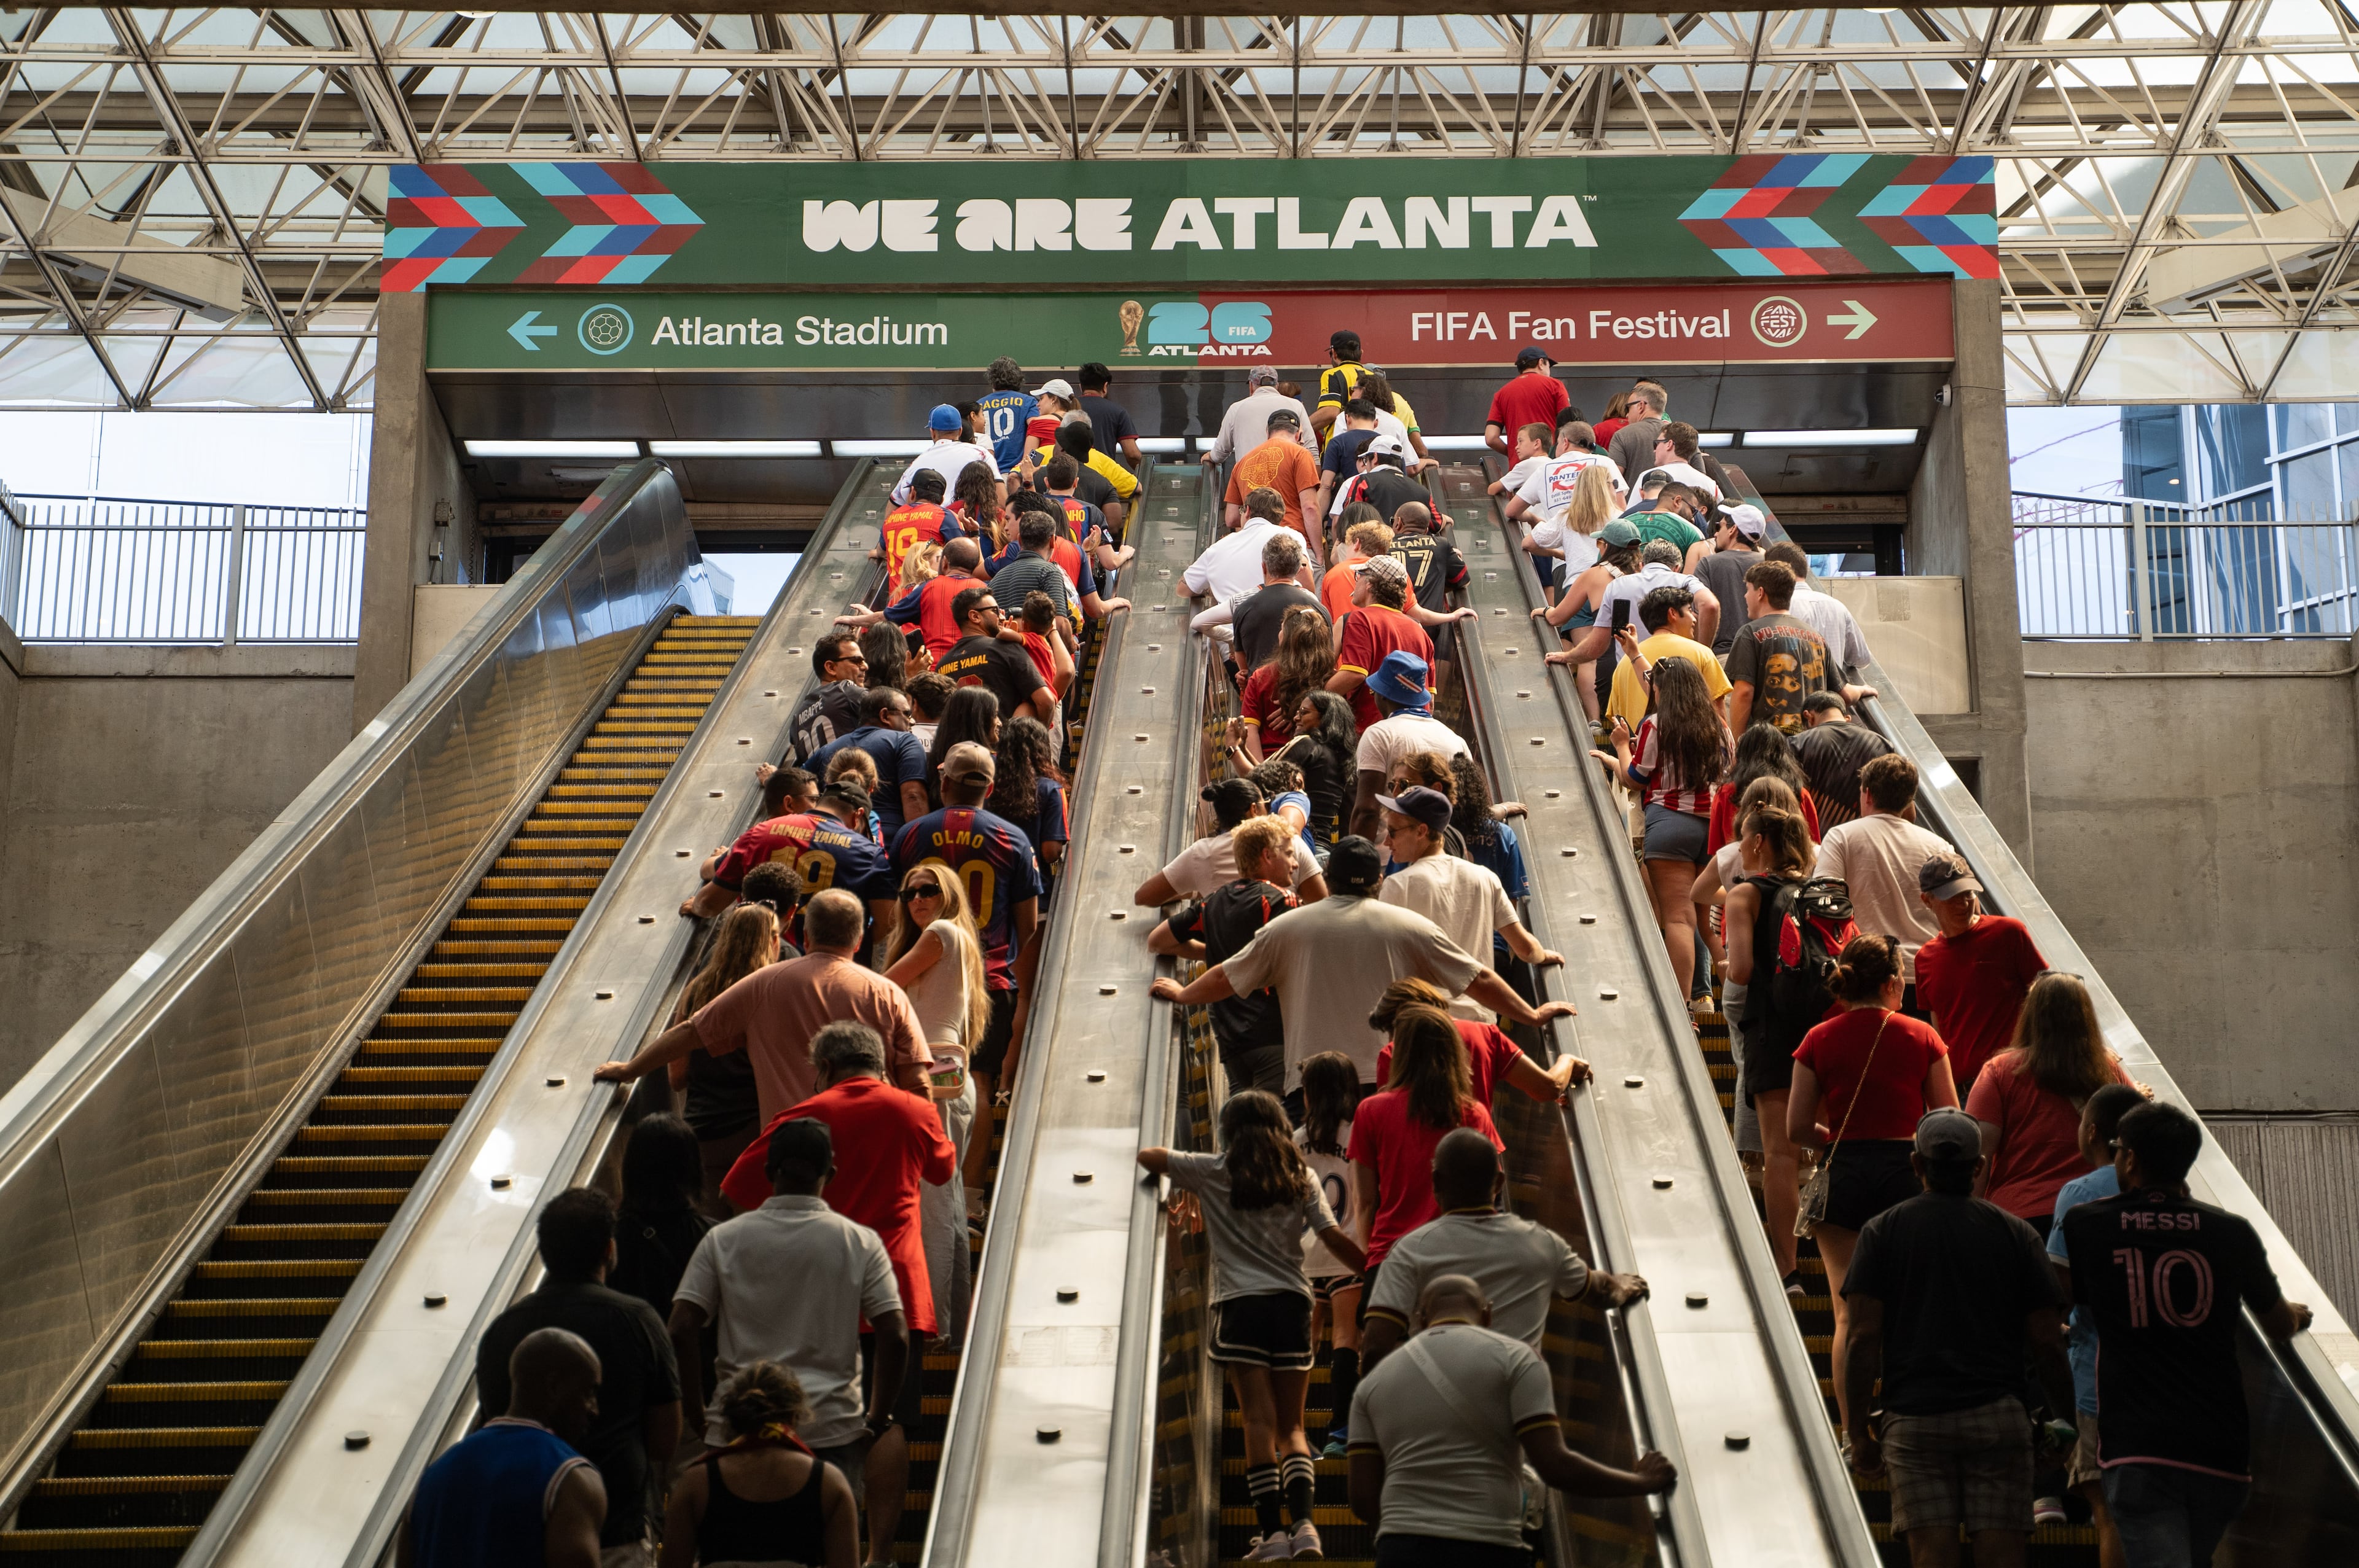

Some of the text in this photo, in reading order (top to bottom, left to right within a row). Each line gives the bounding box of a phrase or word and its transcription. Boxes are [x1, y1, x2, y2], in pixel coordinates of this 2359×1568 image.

[802, 199, 939, 252] WE
[1151, 195, 1598, 250] ATLANTA
[1761, 305, 1796, 316] FAN
[651, 315, 948, 345] Atlanta Stadium
[1412, 308, 1730, 341] FIFA Fan Festival
[1761, 315, 1798, 328] FEST
[1229, 326, 1256, 336] FIFA
[1148, 345, 1273, 356] ATLANTA
[979, 396, 1023, 410] AGGIO
[909, 511, 933, 521] YAMAL
[960, 654, 988, 669] YAMAL
[769, 823, 853, 849] LAMINE YAMAL
[931, 830, 984, 849] OLMO
[2121, 1211, 2201, 1230] MESSI
[2113, 1247, 2214, 1328] 10
